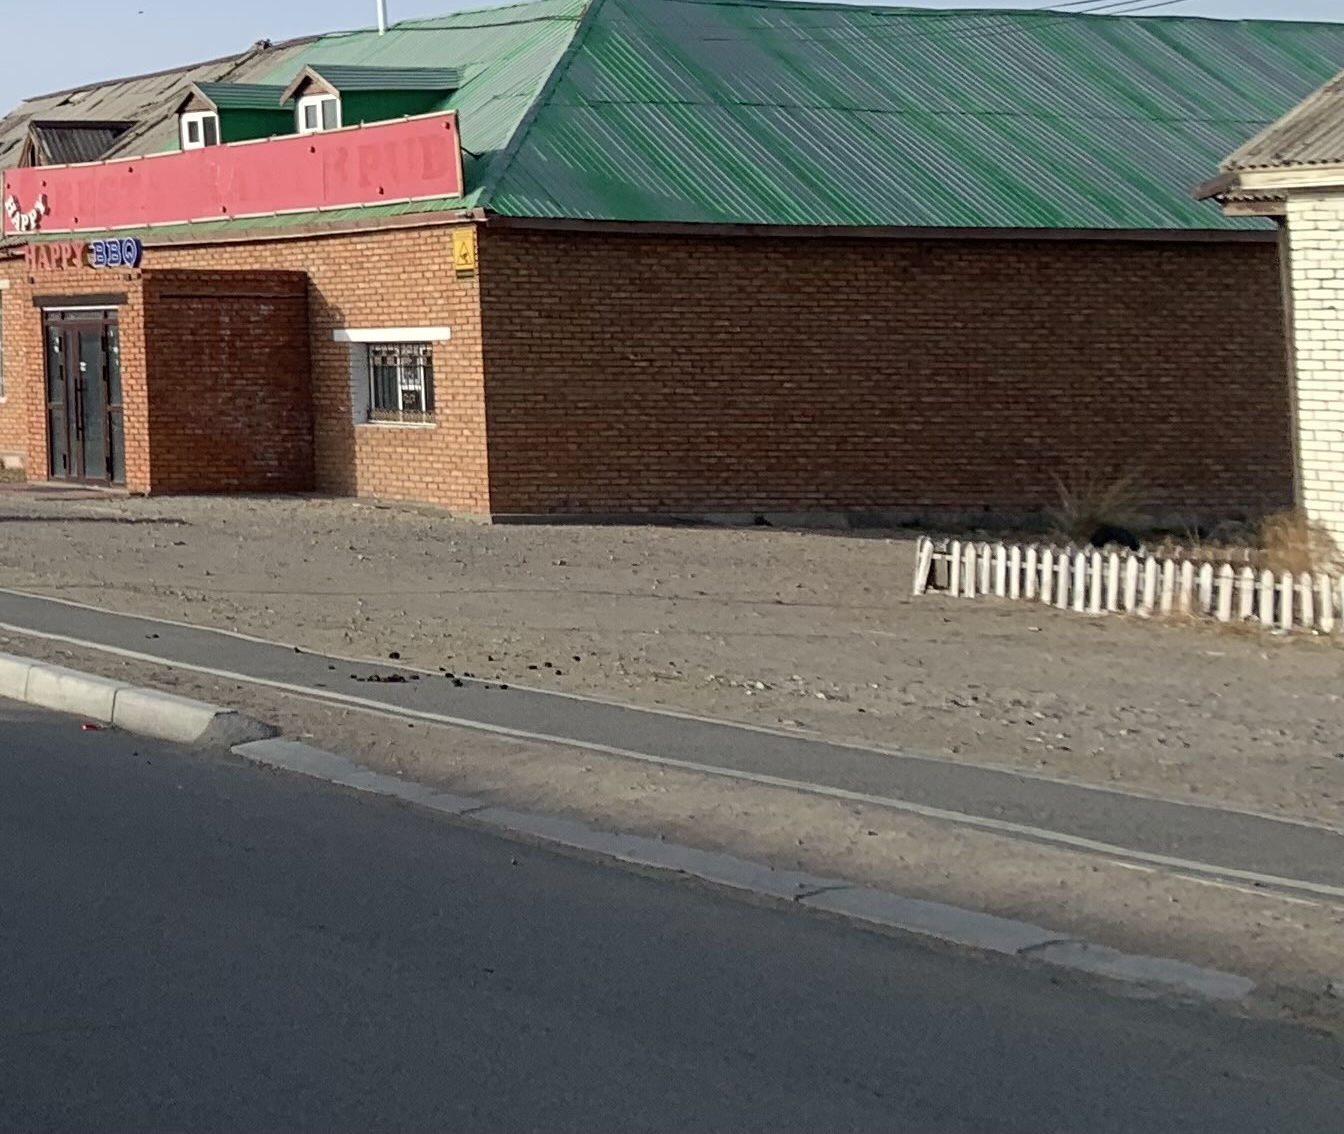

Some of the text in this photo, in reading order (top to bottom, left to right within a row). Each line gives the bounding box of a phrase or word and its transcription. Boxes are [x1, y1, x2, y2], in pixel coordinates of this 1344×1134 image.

[5, 194, 46, 232] HAPPY
[24, 236, 141, 271] HAPPY BBQ
